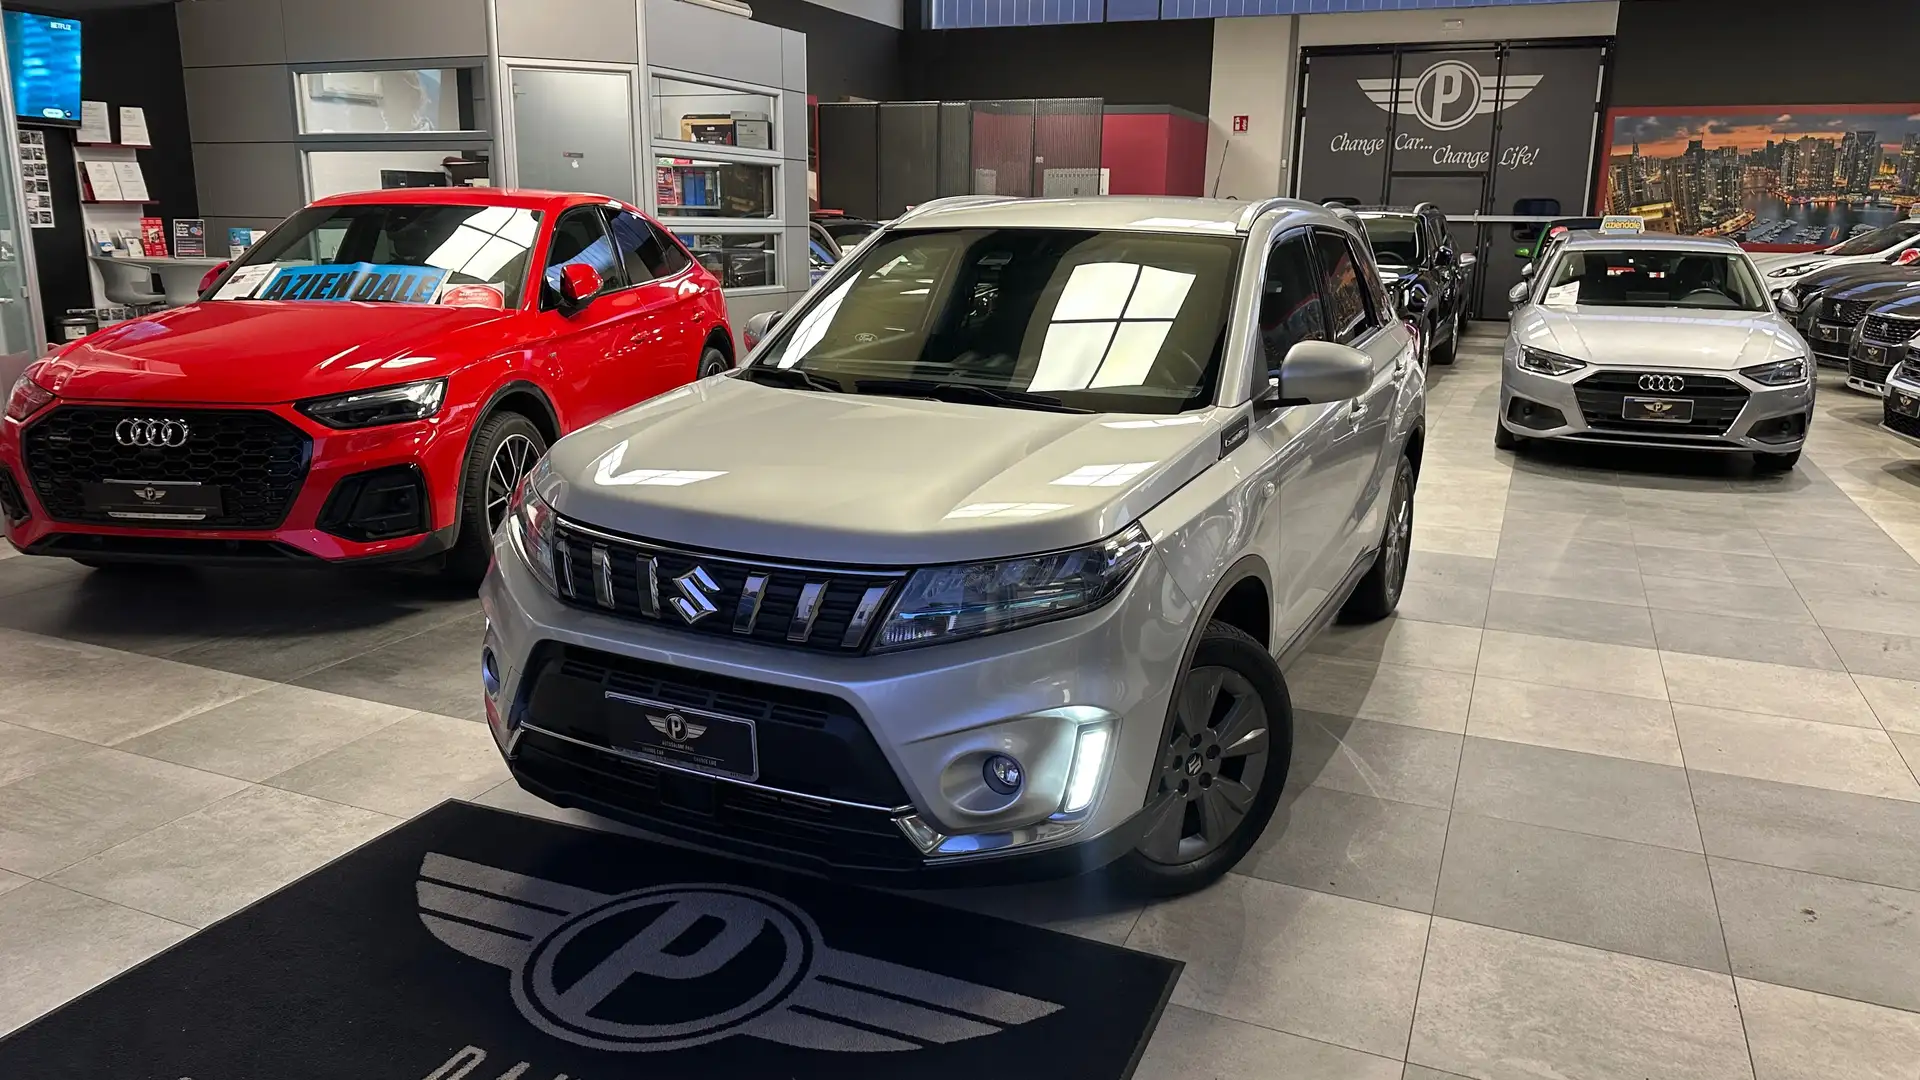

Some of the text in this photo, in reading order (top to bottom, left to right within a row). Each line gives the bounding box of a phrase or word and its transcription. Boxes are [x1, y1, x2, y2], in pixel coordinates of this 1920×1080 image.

[1432, 67, 1463, 123] P
[1330, 132, 1433, 156] Change Car...
[1432, 144, 1540, 170] Change Life!
[1605, 219, 1641, 230] aziendale
[265, 271, 438, 304] AZIENDALE
